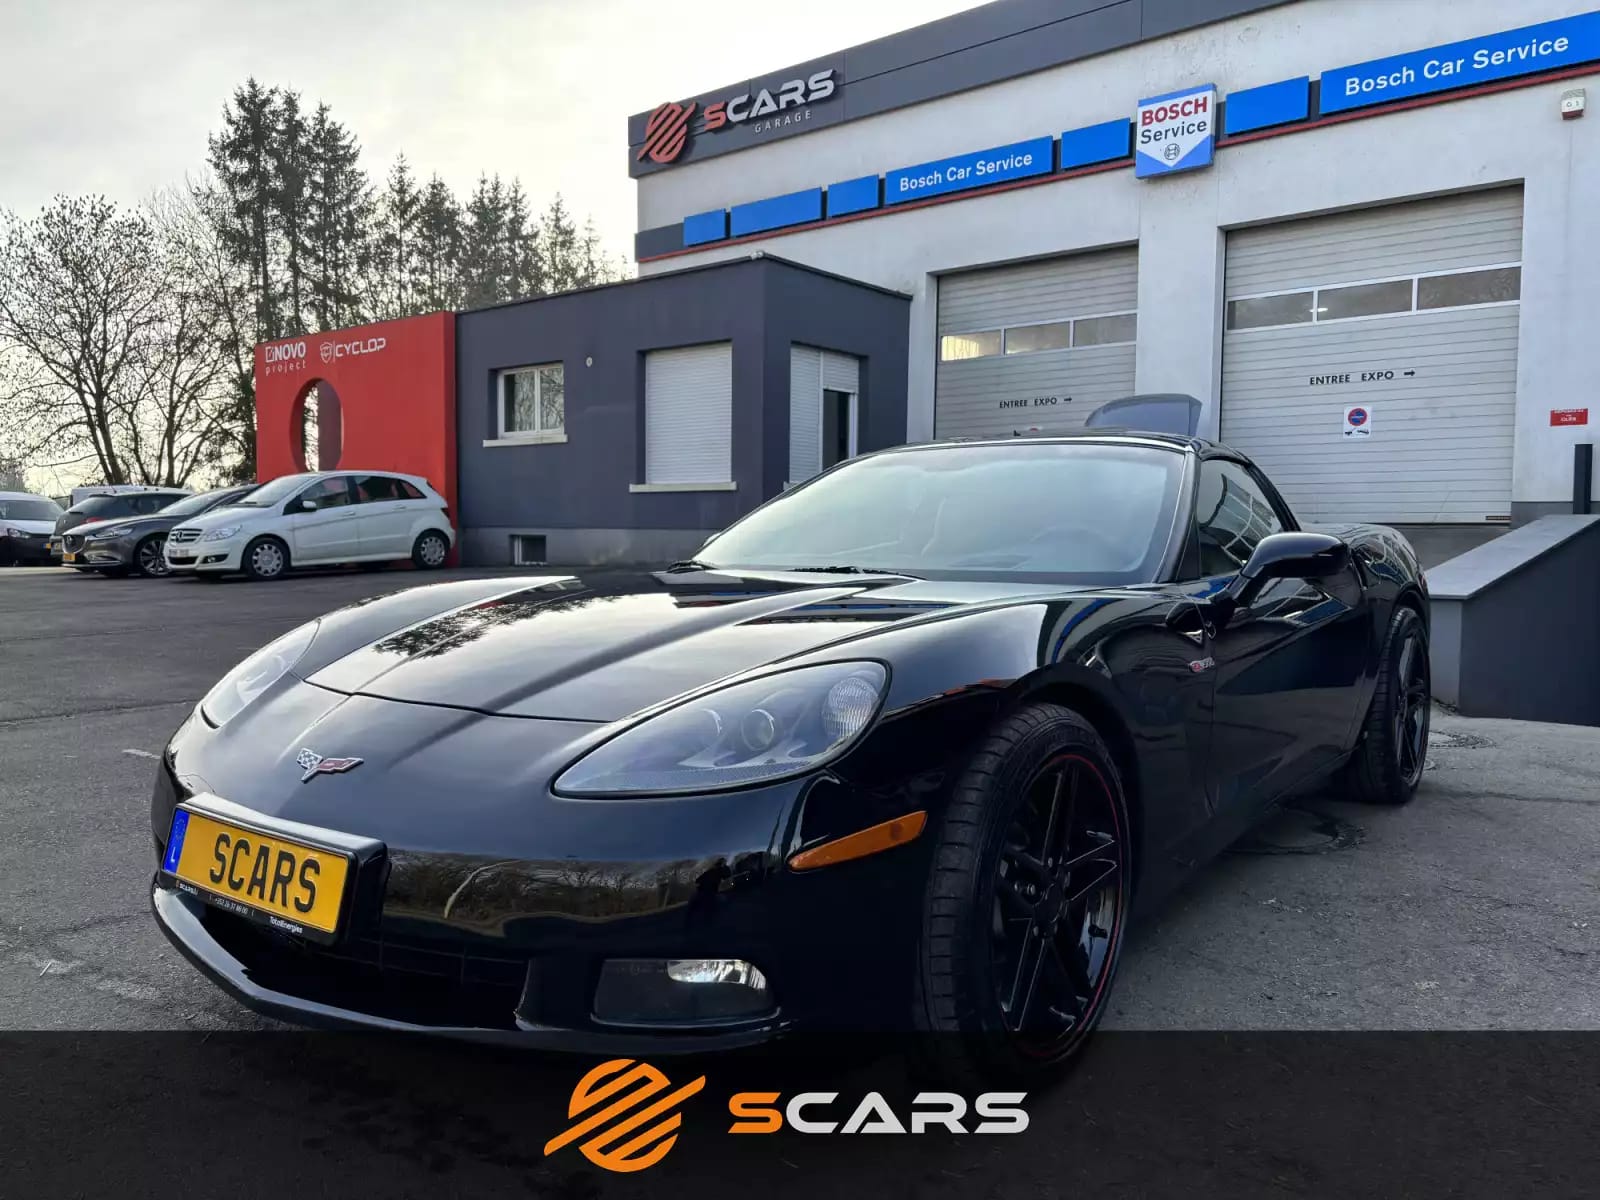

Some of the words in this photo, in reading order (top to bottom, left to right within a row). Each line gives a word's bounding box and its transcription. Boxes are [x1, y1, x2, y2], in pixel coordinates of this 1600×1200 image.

[1345, 66, 1414, 96] Bosch
[1423, 58, 1465, 79] Car
[1472, 36, 1569, 69] Service
[704, 69, 835, 131] SCARS
[1141, 96, 1208, 127] BOSCH
[755, 111, 812, 133] GARAGE
[1140, 120, 1207, 144] Service
[900, 172, 942, 192] Bosch
[946, 166, 972, 182] Car
[976, 154, 1033, 175] Service
[335, 337, 386, 357] CYCLOP
[265, 360, 306, 376] project
[1309, 374, 1350, 385] ENTREE
[1361, 370, 1394, 382] EXPO
[999, 399, 1028, 409] ENTREE
[1034, 397, 1057, 406] EXPO
[209, 831, 320, 913] SCARS
